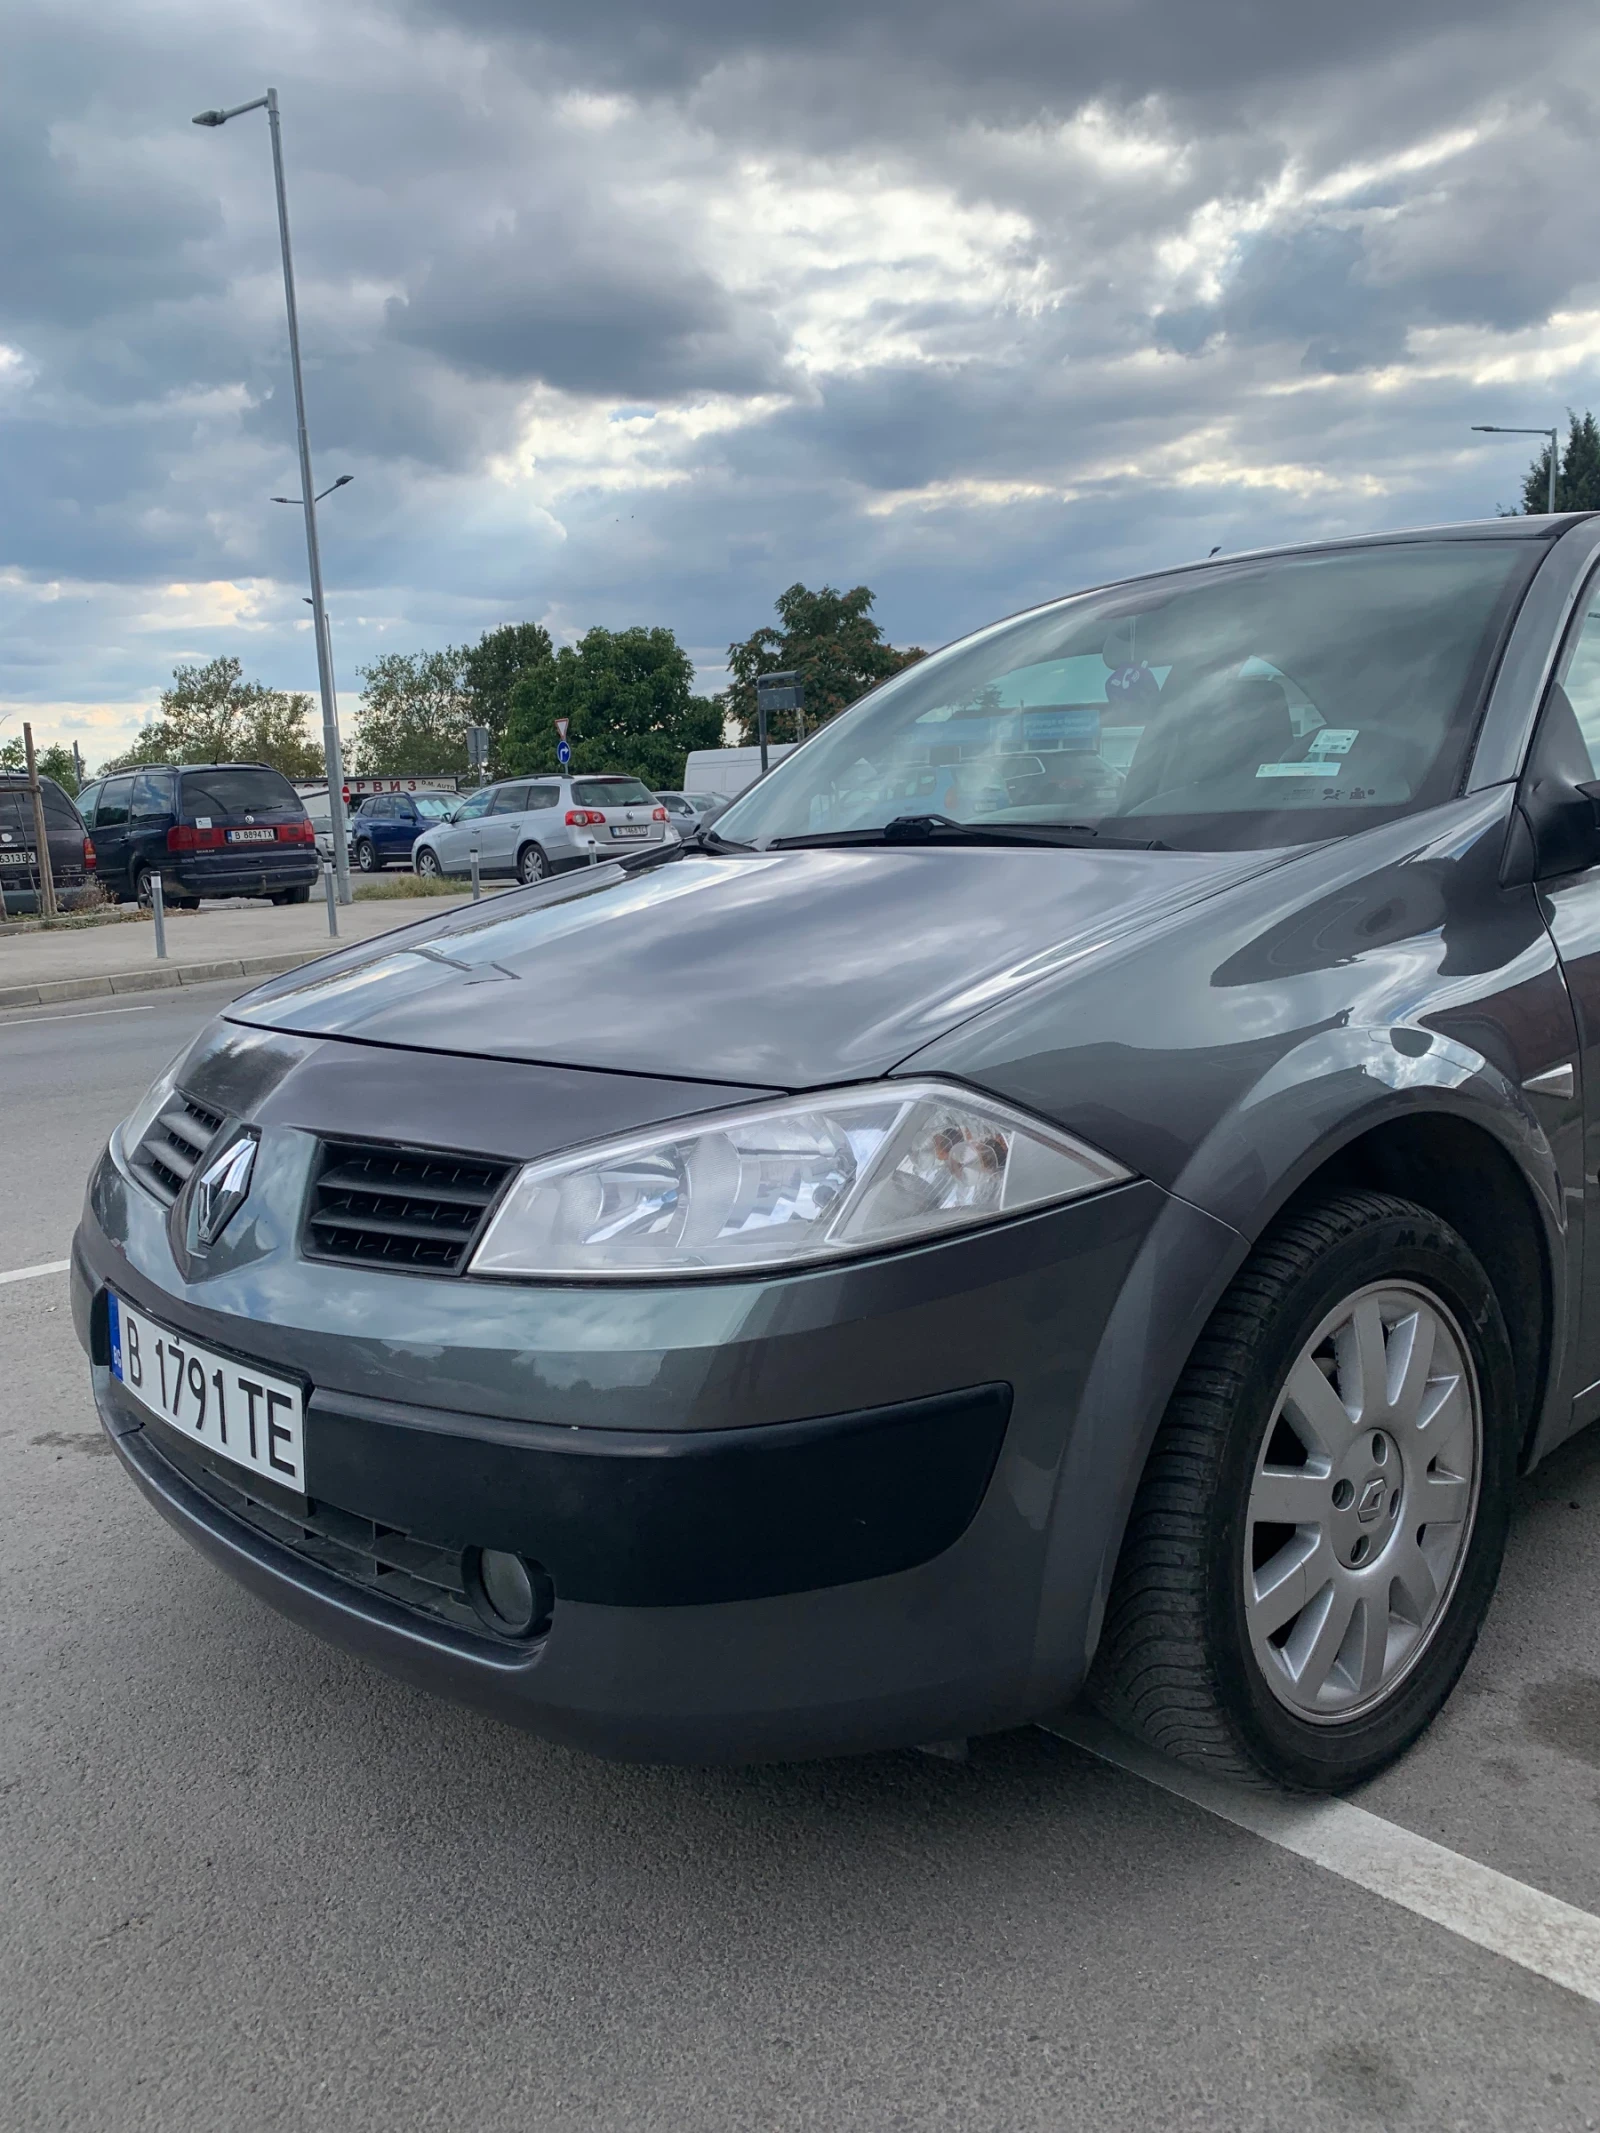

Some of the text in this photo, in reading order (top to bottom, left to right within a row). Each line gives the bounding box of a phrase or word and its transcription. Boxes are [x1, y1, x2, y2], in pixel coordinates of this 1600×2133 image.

[127, 1316, 296, 1478] B 1791 TE
